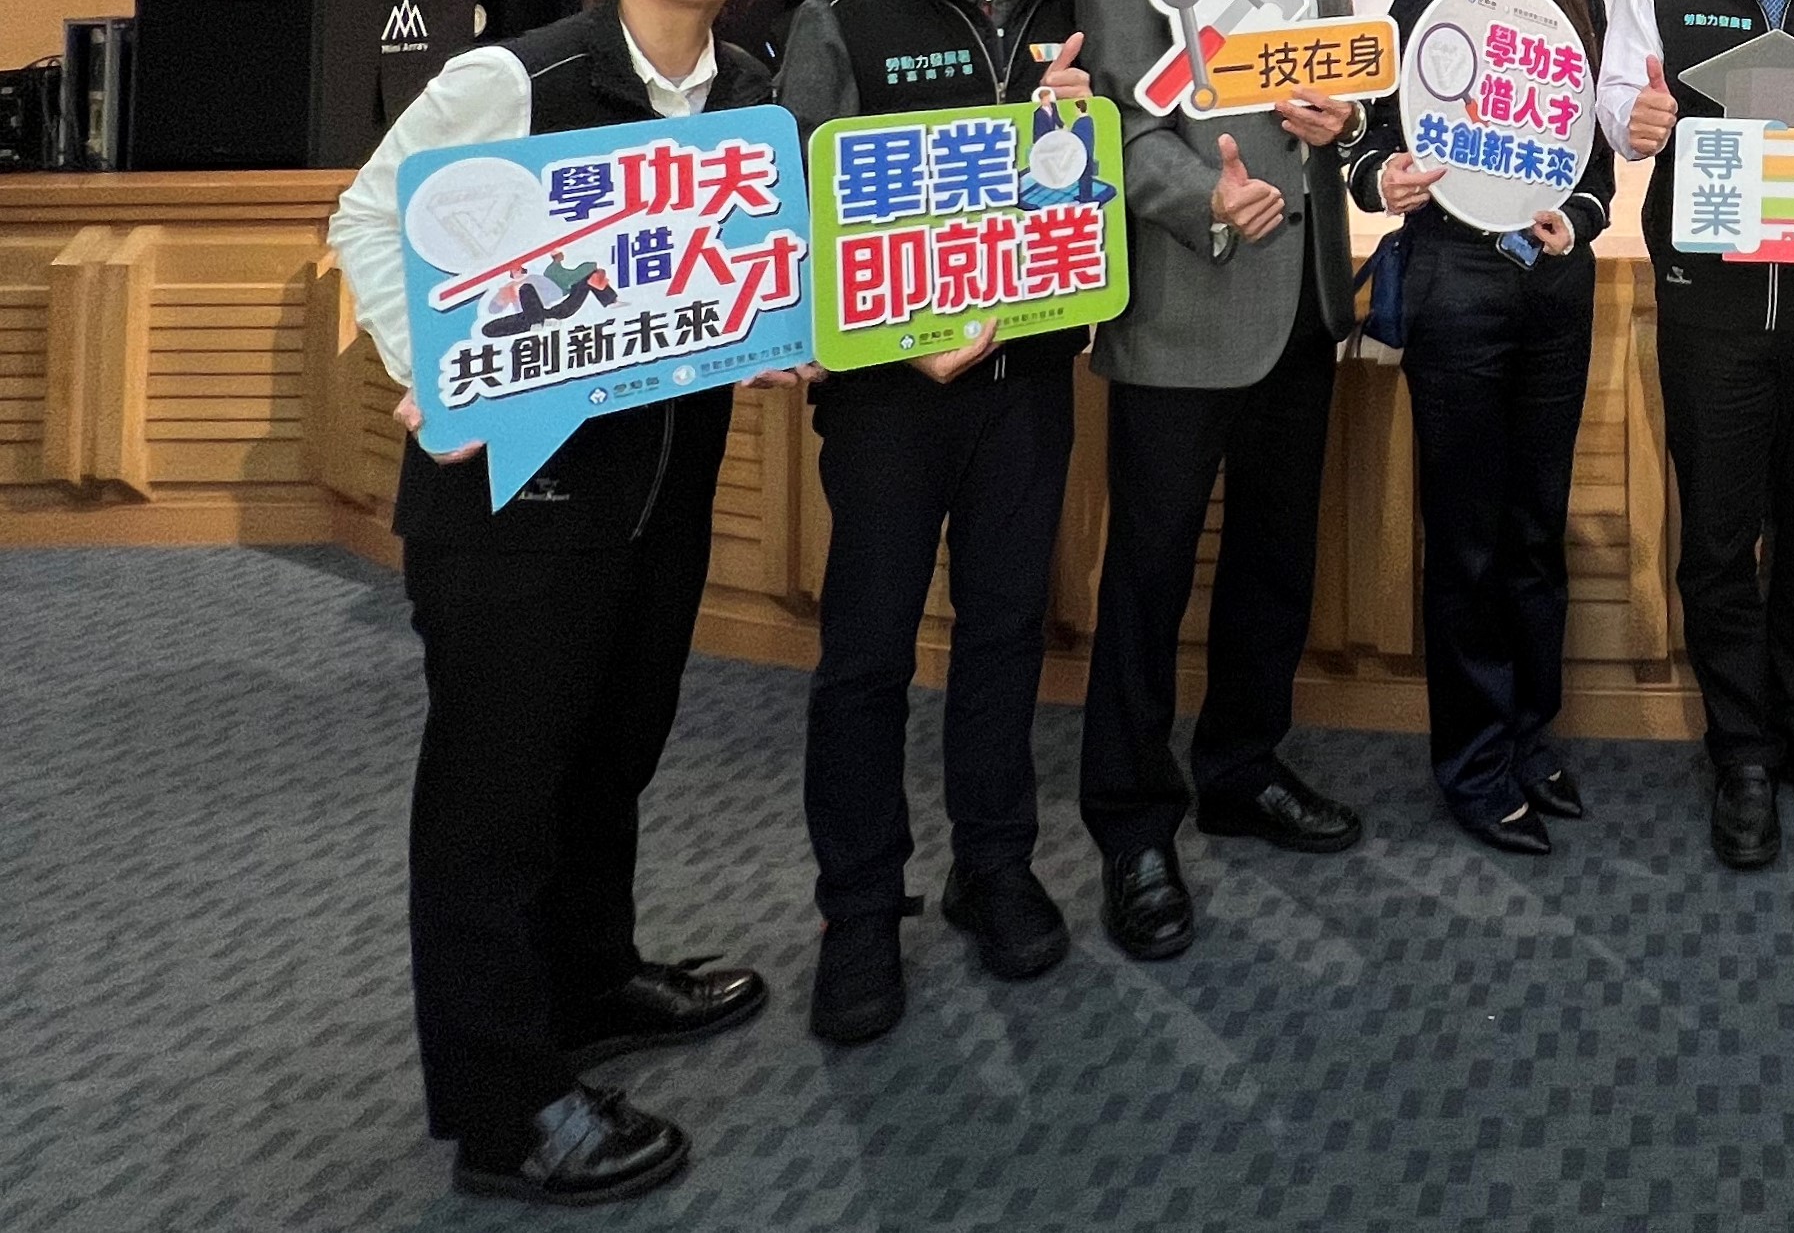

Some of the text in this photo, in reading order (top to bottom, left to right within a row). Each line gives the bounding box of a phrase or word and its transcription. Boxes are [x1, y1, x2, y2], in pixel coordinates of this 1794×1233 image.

[1212, 32, 1385, 90] 一技在身
[1483, 22, 1586, 89] 學功夫
[1479, 73, 1580, 136] 惜人才
[548, 144, 771, 223] 學功夫
[837, 120, 1015, 221] 畢業
[1415, 113, 1578, 188] 共創新未來
[1690, 127, 1744, 237] 專業
[610, 224, 799, 335] 惜人才
[840, 205, 1103, 327] 即就業
[448, 298, 721, 397] 共創新未來
